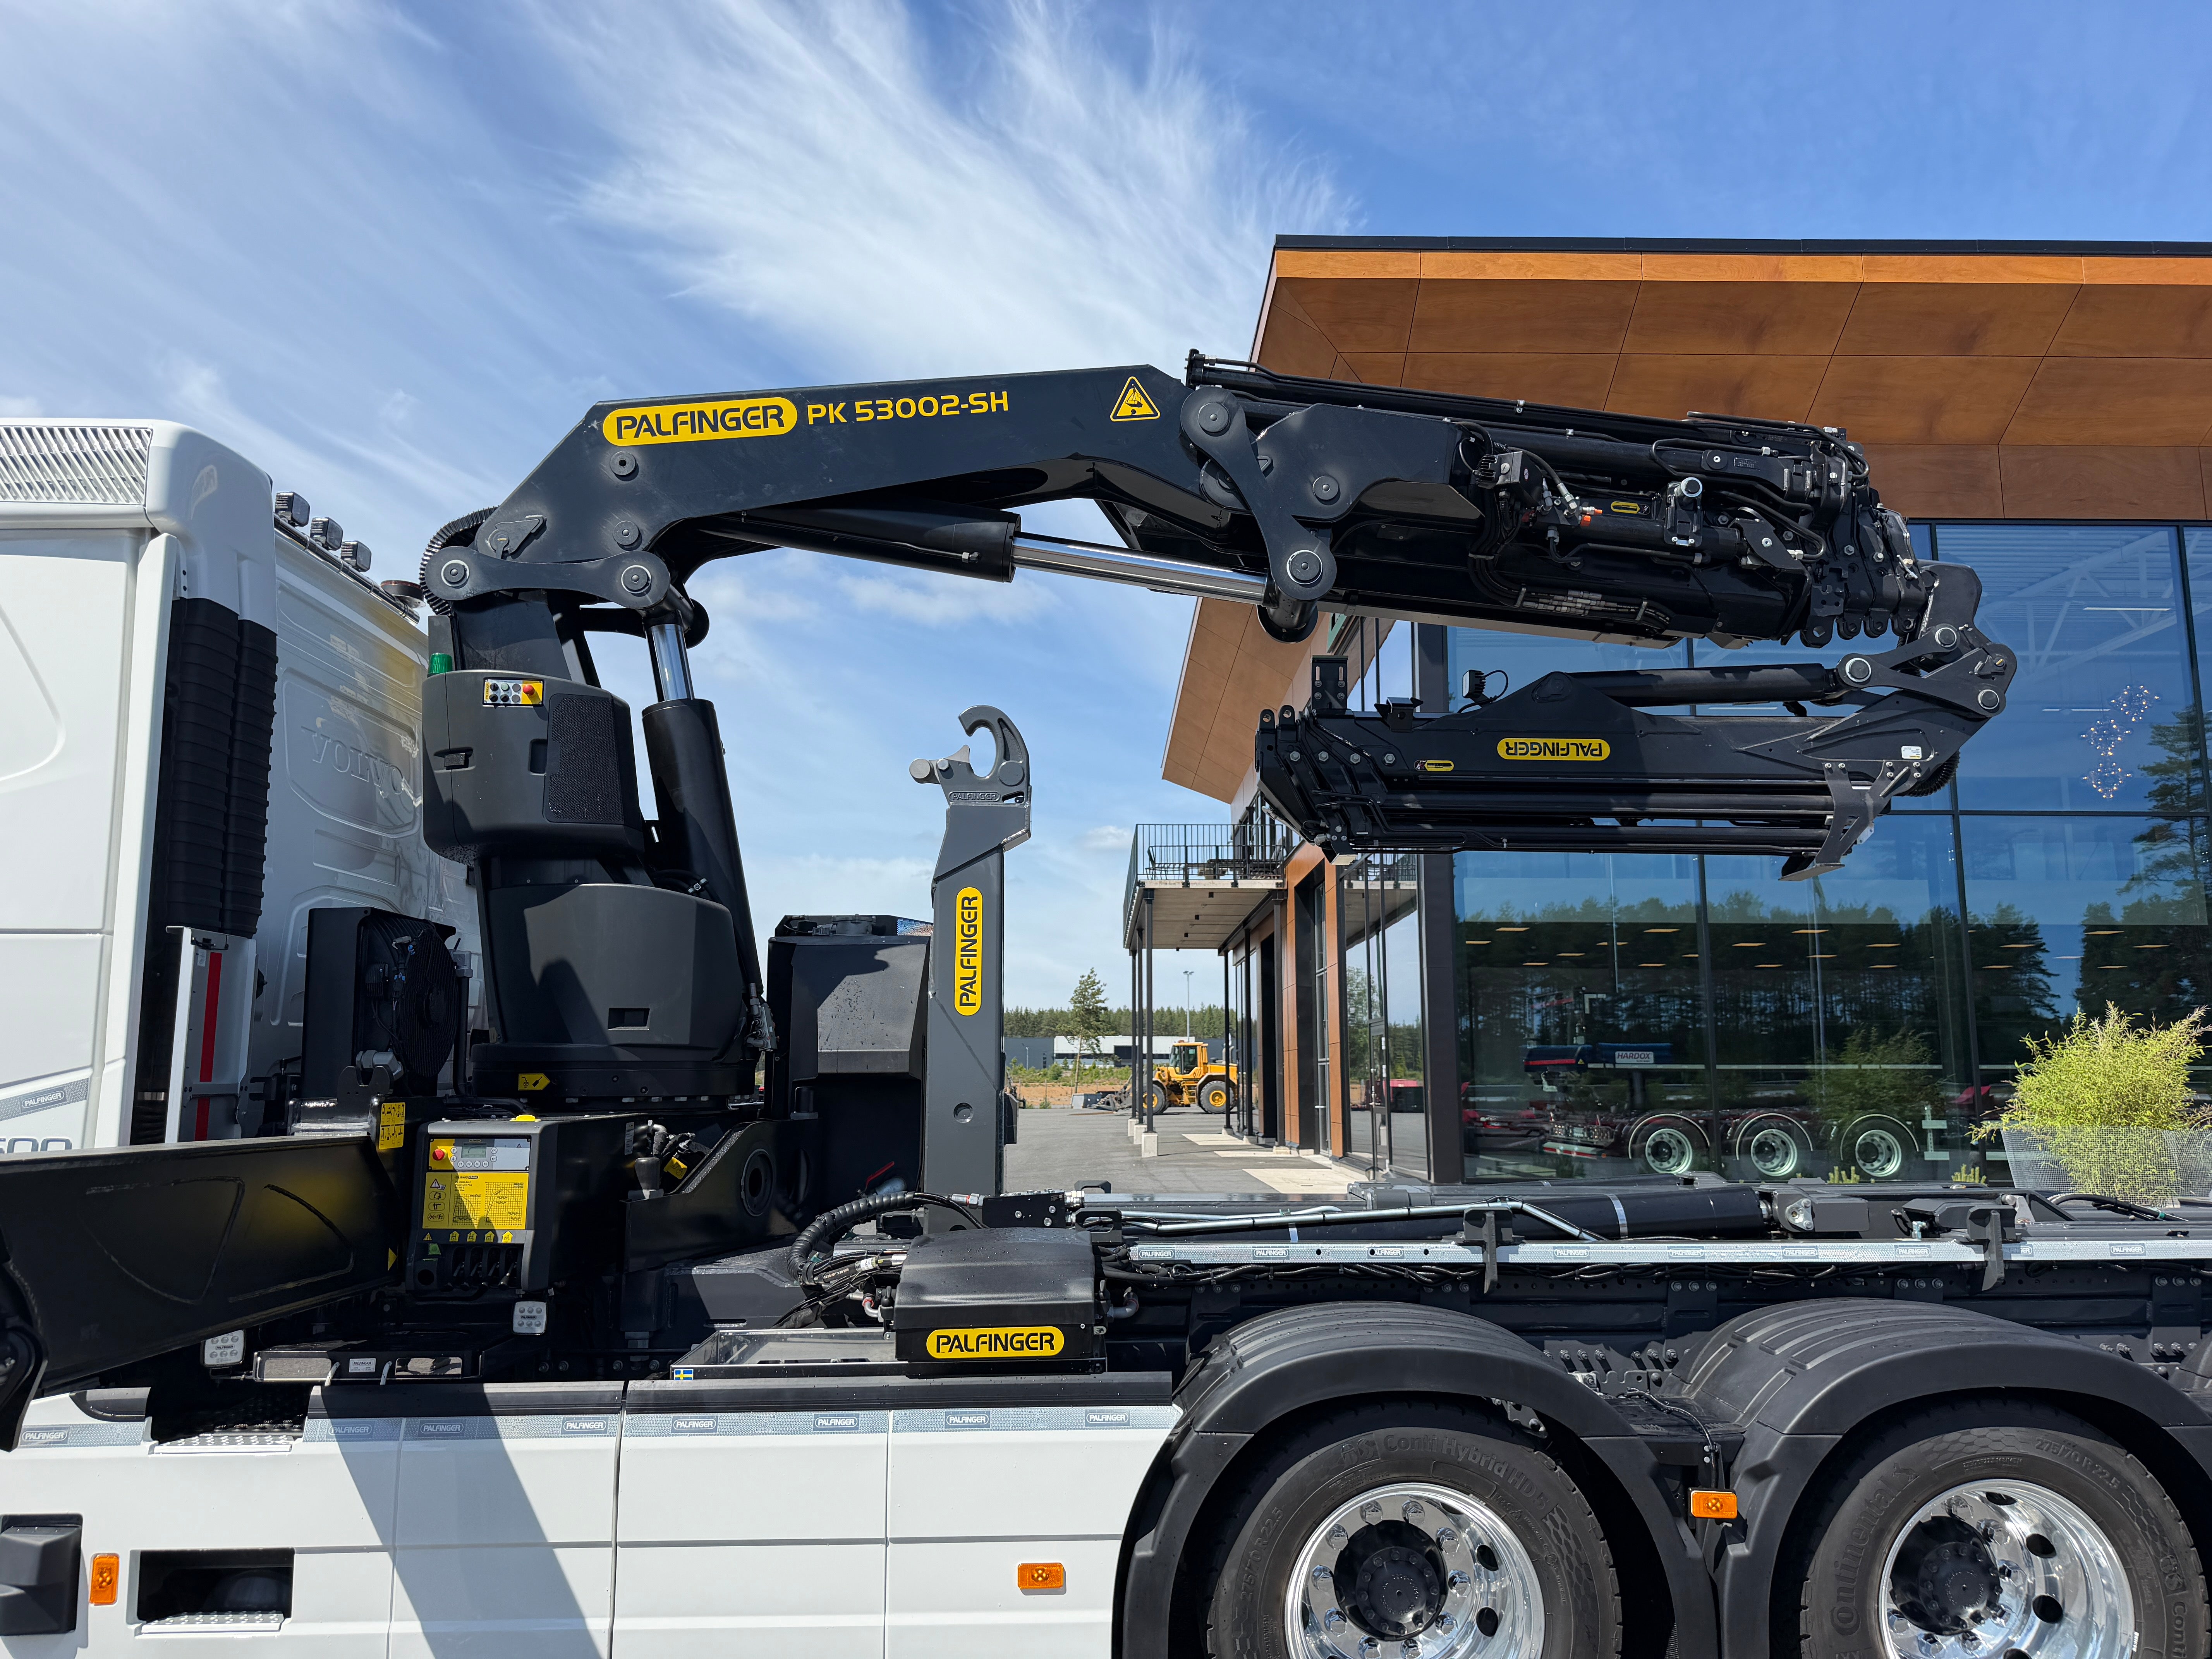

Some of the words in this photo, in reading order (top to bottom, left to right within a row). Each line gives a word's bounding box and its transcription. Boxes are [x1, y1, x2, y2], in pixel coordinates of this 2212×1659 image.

[617, 405, 785, 439] PALFINGER
[807, 402, 847, 425] PK
[855, 391, 1009, 421] 53002-SH
[1505, 741, 1602, 757] PALFINGER
[952, 792, 997, 800] PALFINGER
[959, 896, 978, 1006] PALFINGER
[25, 1092, 62, 1107] PALFINGER
[936, 1332, 1055, 1353] PALFINGER
[333, 1425, 368, 1433] PALFINGER
[1383, 1434, 1437, 1452] Conti
[1442, 1437, 1509, 1478] Hybrid
[1508, 1466, 1538, 1497] HD
[2035, 1437, 2081, 1463] 275/70
[2081, 1456, 2094, 1471] R
[2092, 1464, 2121, 1489] 22.5
[1261, 1507, 1283, 1539] 22.5
[1255, 1537, 1269, 1547] R
[1830, 1476, 1898, 1636] Continental
[1240, 1550, 1262, 1601] 275/70
[2172, 1601, 2187, 1658] Conti
